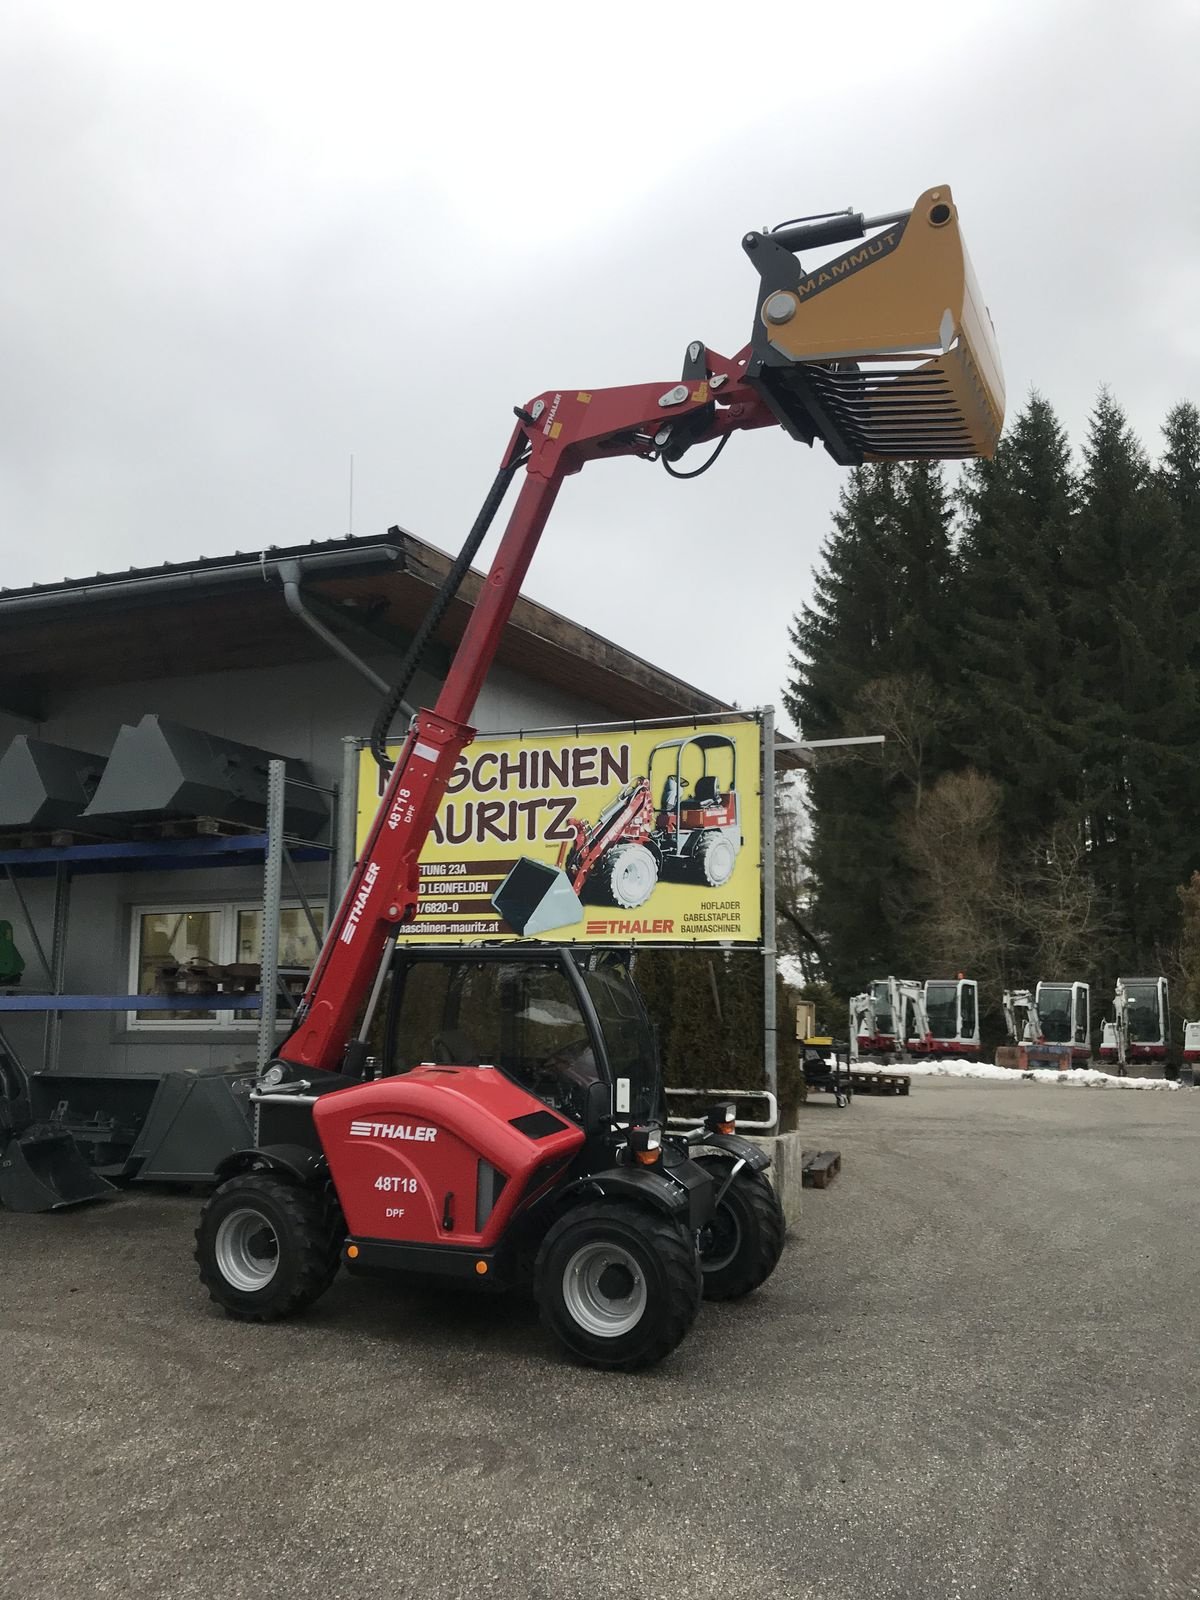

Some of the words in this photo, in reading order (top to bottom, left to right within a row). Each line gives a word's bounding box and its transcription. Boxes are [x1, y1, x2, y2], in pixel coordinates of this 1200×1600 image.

[797, 233, 896, 296] MAMMUT
[388, 789, 411, 830] 48T18
[404, 804, 416, 823] DPF
[448, 864, 467, 875] 23A
[347, 862, 381, 925] THALER
[428, 882, 489, 894] LEONFELDEN
[701, 901, 741, 910] HOFLADER
[683, 913, 741, 922] GABELSTAPLER
[606, 919, 675, 934] THALER
[680, 924, 741, 933] BAUMASCHINEN
[370, 1122, 438, 1143] THALER
[374, 1176, 418, 1194] 48T18
[385, 1208, 405, 1218] DPF
